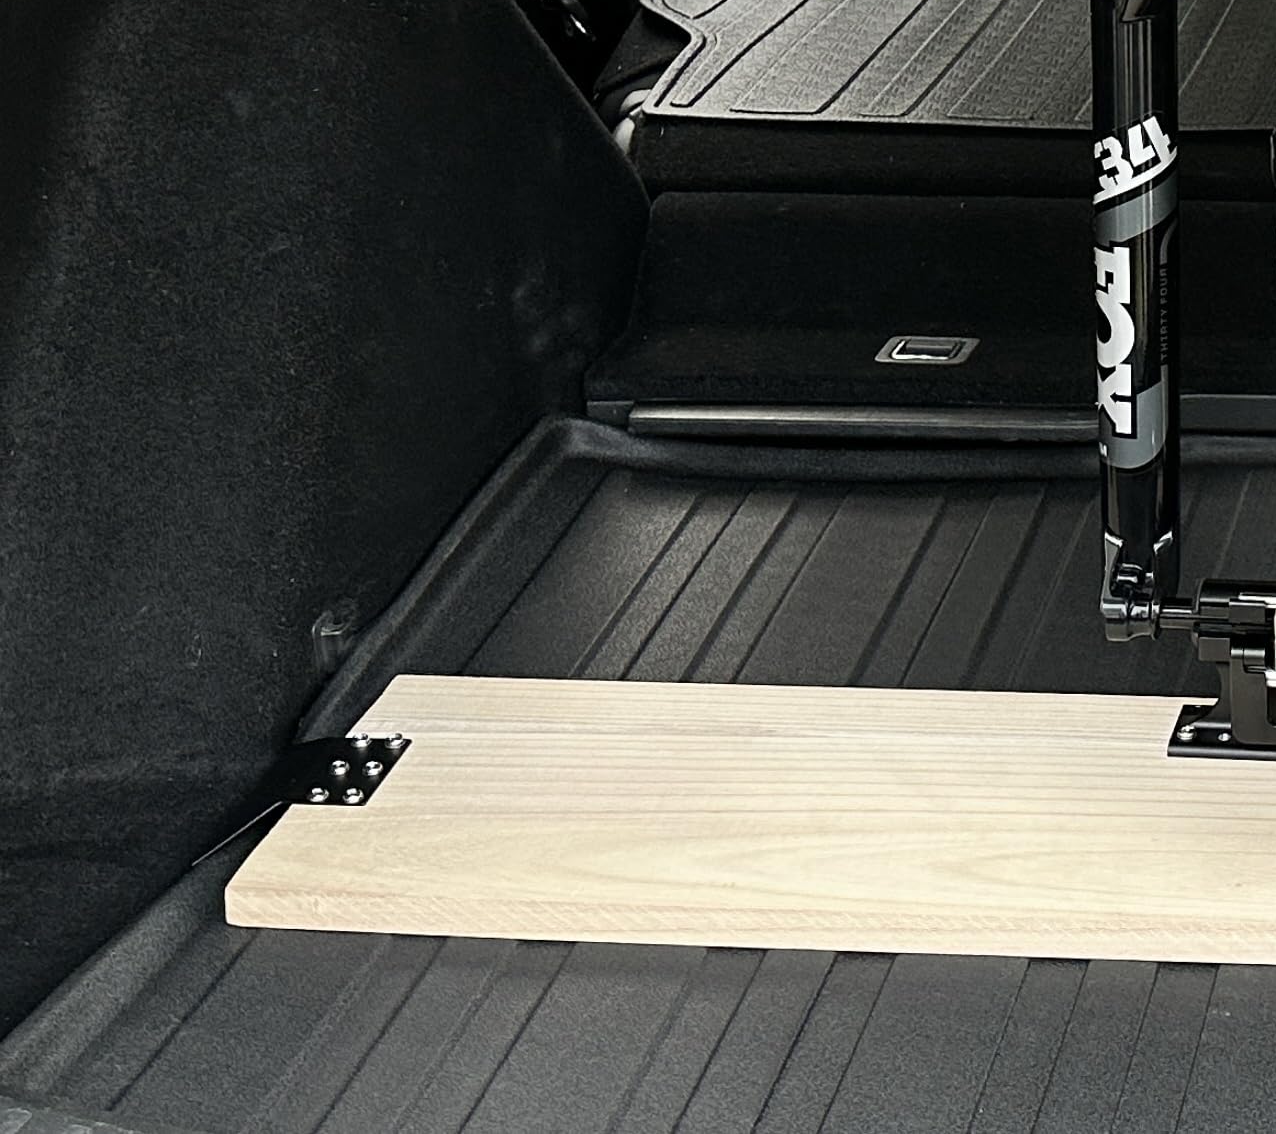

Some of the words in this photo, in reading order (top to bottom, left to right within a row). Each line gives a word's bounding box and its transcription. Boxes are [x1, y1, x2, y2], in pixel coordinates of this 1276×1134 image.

[1093, 116, 1177, 198] 34
[1159, 267, 1167, 305] FOUR
[1094, 246, 1135, 434] FOX
